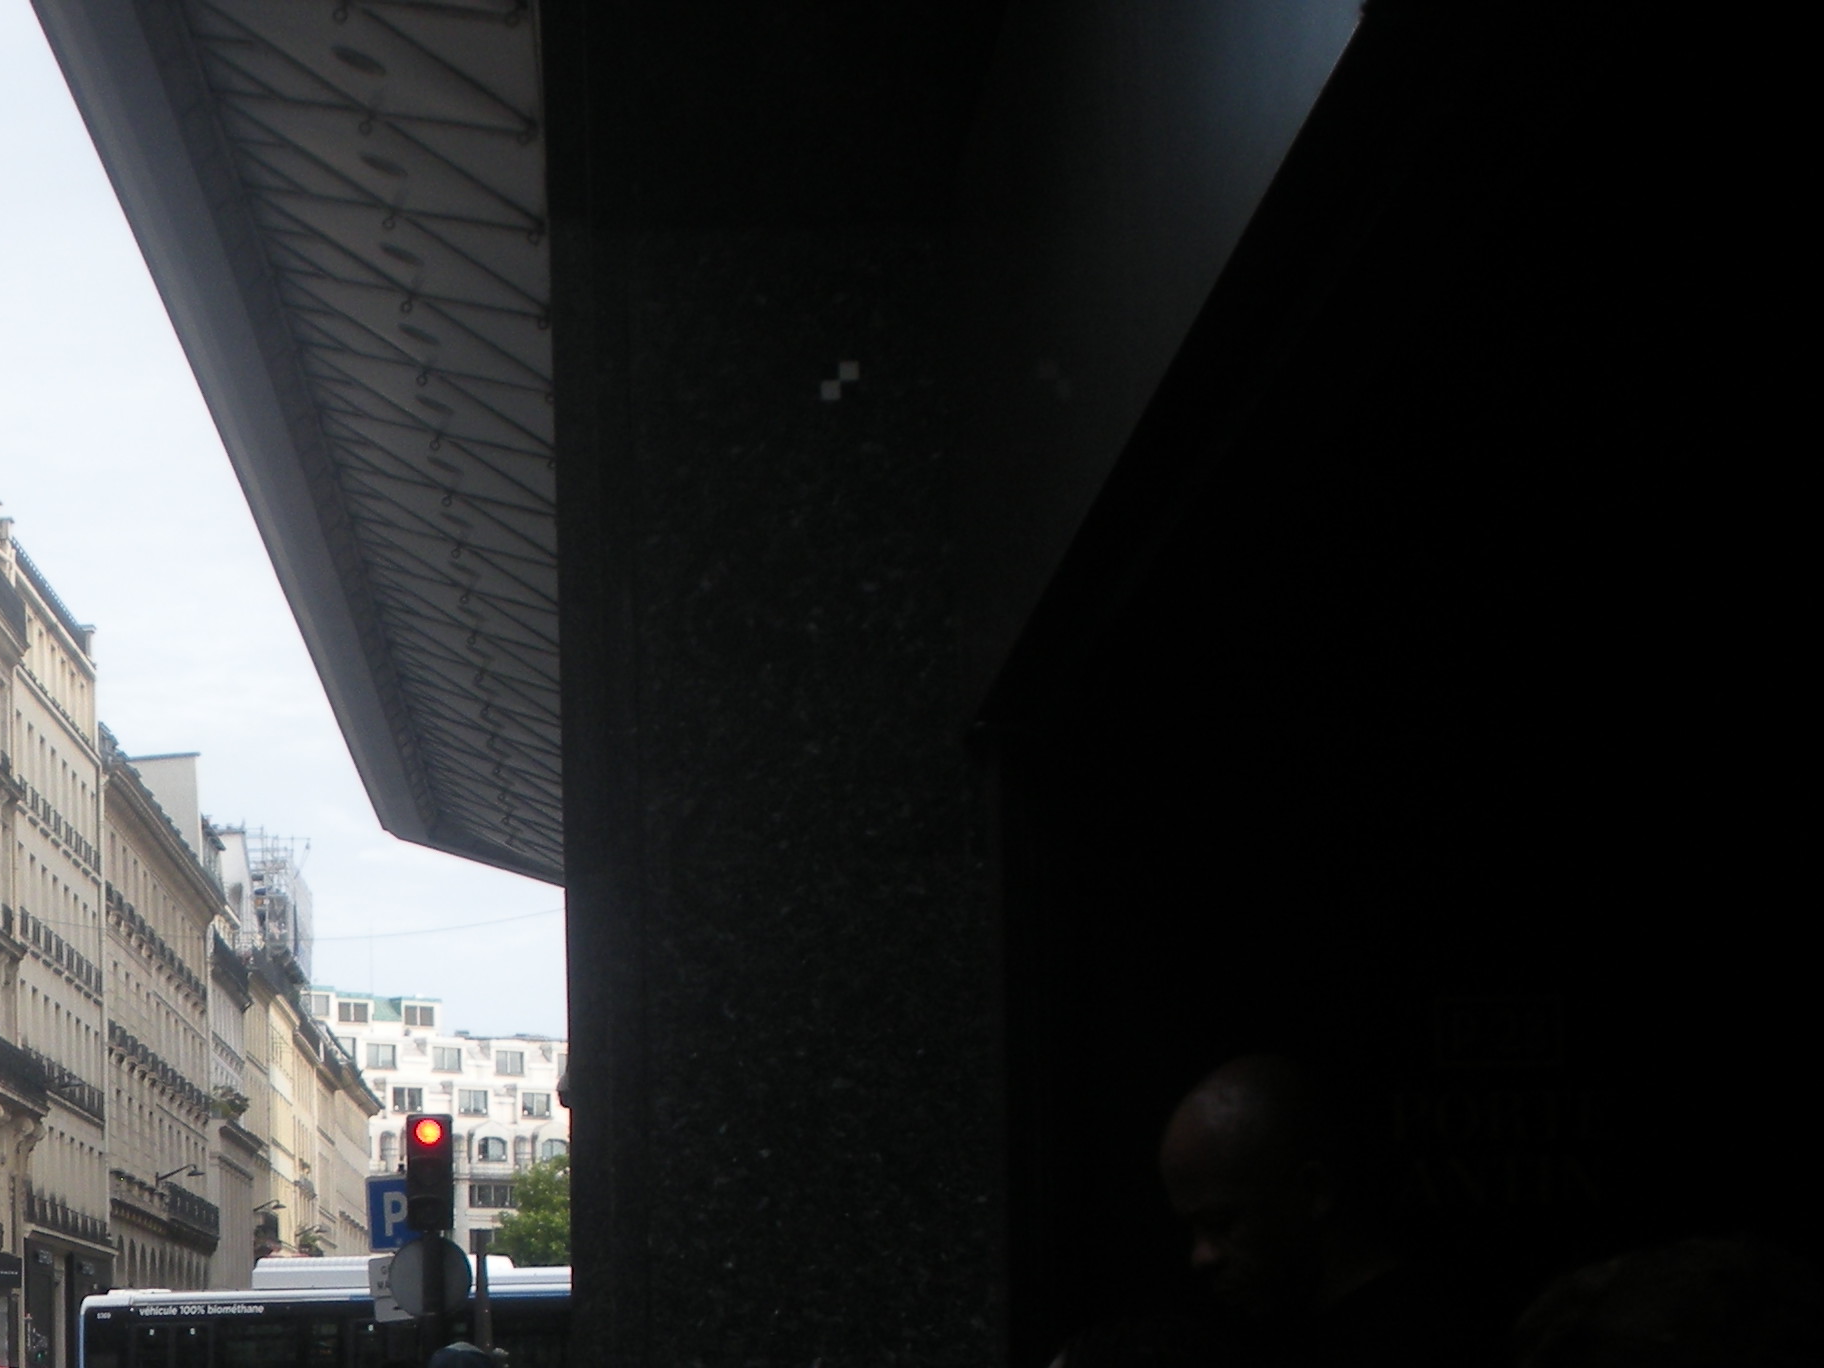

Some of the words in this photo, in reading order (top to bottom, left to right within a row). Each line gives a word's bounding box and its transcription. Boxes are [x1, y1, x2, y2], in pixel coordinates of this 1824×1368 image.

[382, 1191, 408, 1237] P
[139, 1304, 178, 1317] véhicule
[179, 1304, 205, 1316] 100%
[207, 1303, 265, 1315] biométhane
